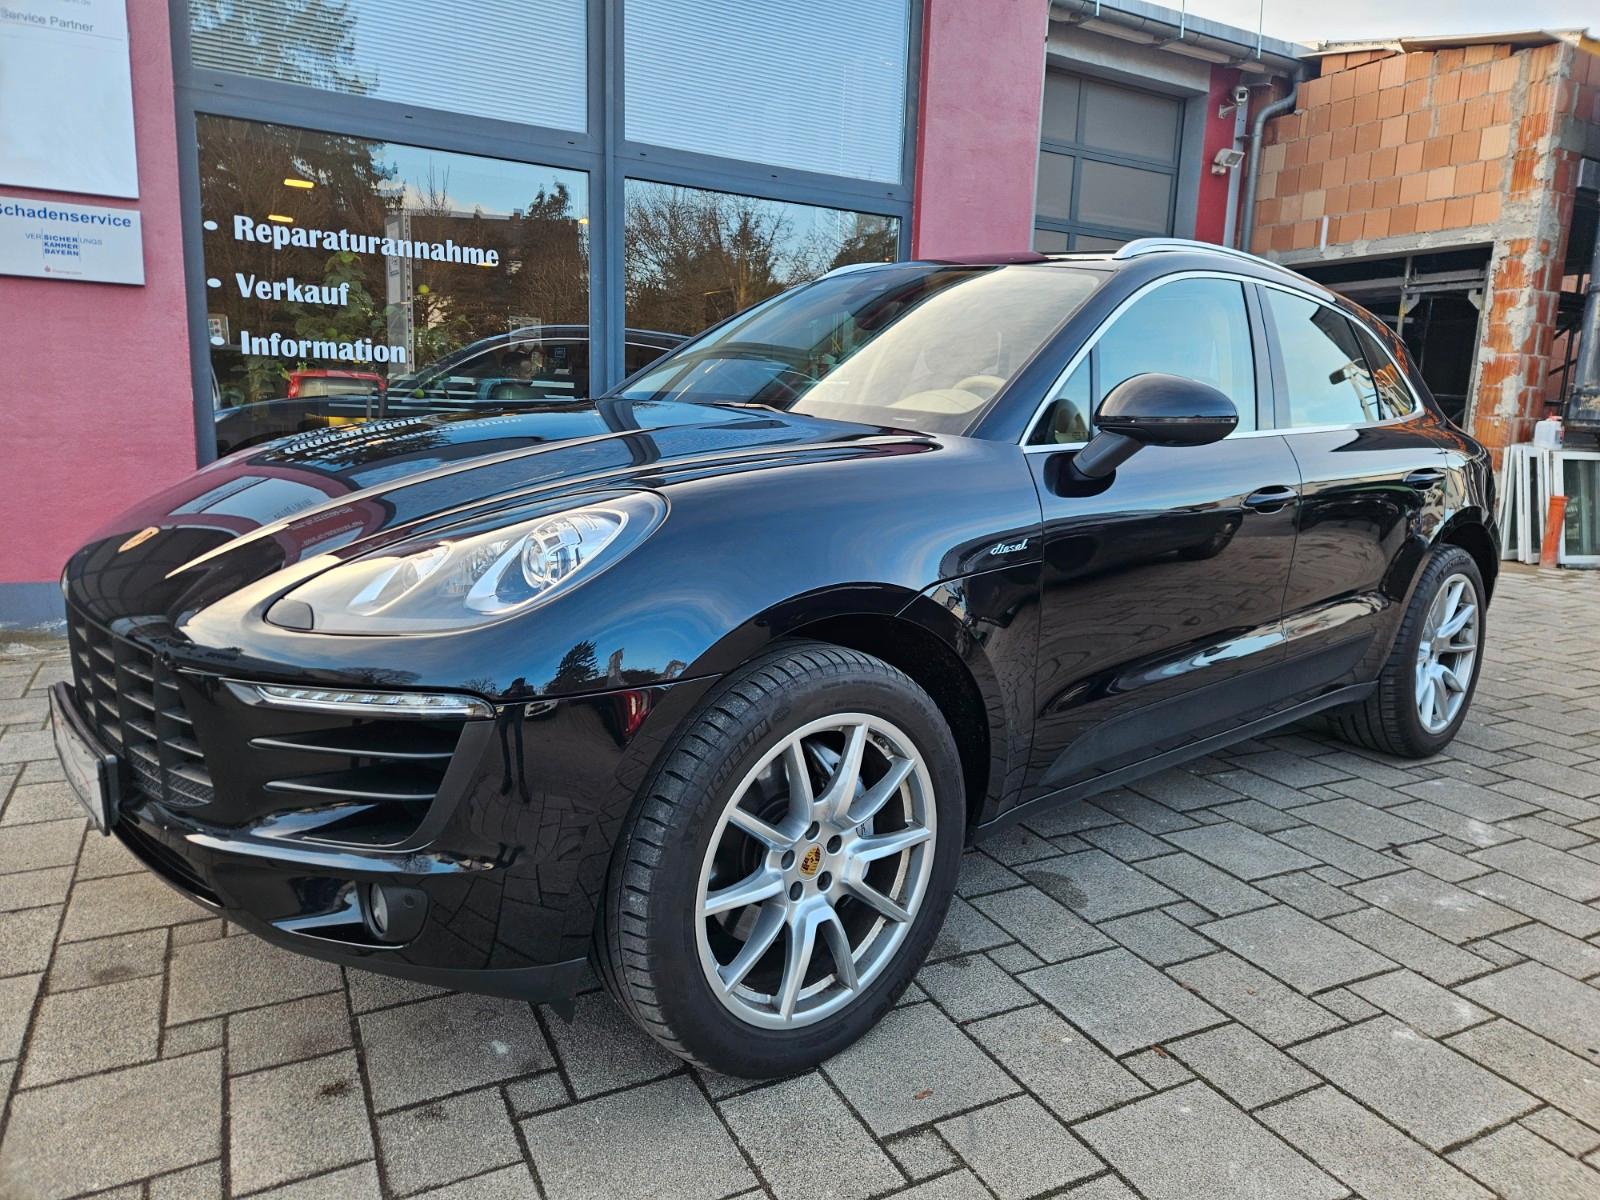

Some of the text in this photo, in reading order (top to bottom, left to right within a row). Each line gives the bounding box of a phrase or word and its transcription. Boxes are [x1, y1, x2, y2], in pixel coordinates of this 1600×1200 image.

[50, 16, 94, 32] Partner
[0, 203, 131, 228] chadenservice
[44, 241, 79, 250] KAMMER
[233, 214, 500, 267] Reparaturannahme
[44, 248, 79, 257] BAYERN
[235, 272, 350, 306] Verkauf
[240, 330, 407, 364] Information
[990, 538, 1028, 555] diesel
